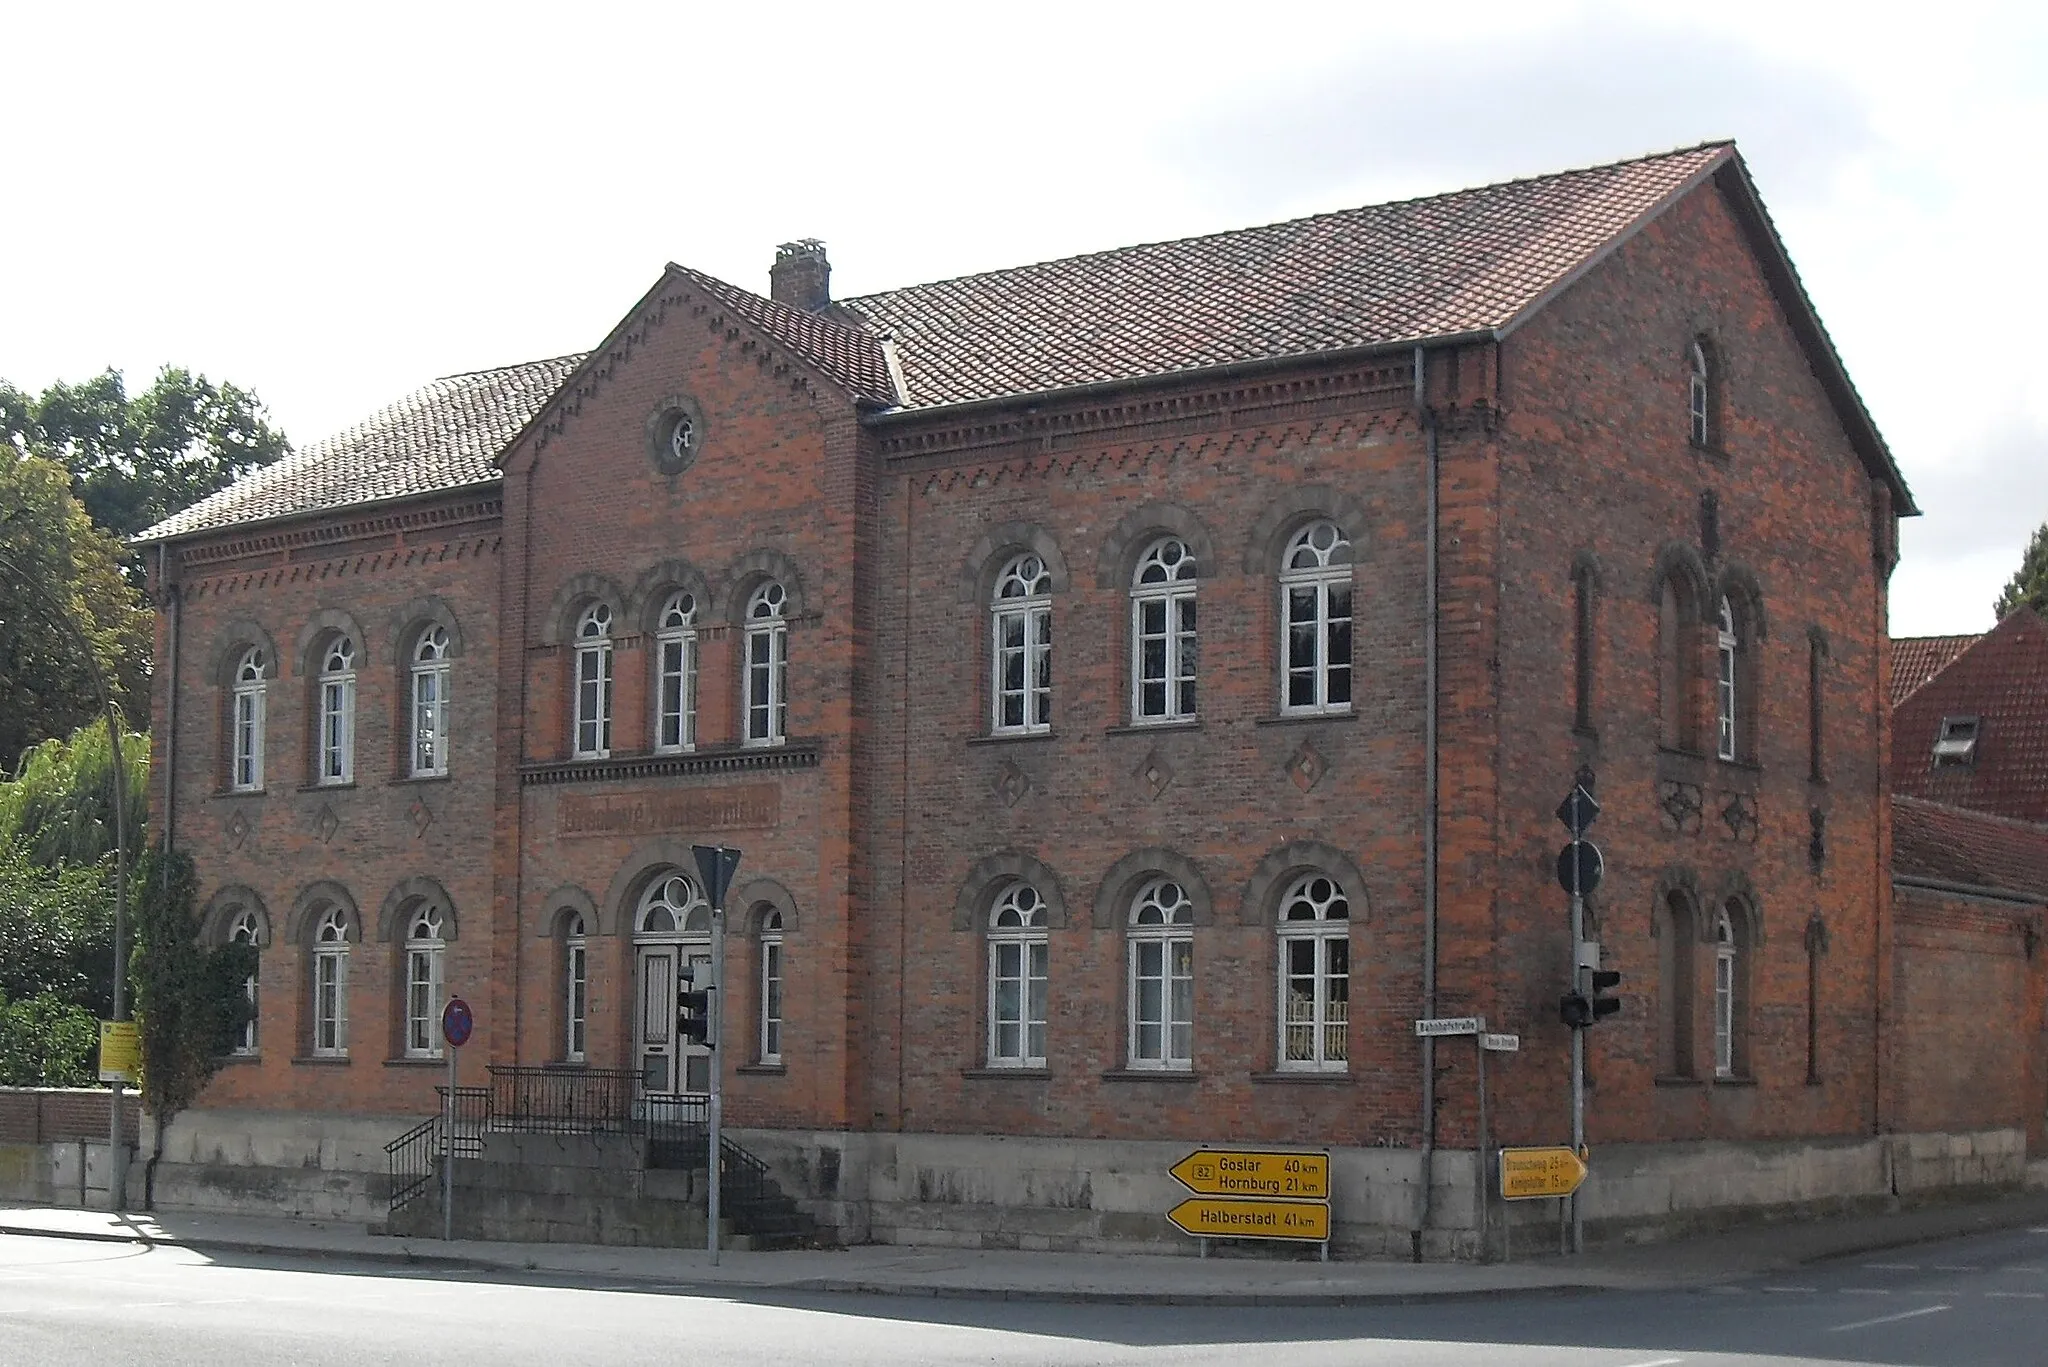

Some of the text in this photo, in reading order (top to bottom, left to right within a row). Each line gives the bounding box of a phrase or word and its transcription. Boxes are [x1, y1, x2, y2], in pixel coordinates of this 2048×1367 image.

[1219, 1157, 1318, 1174] Goslar 40 km
[1550, 1156, 1559, 1169] 25
[1197, 1167, 1210, 1178] 82
[1219, 1176, 1318, 1194] Hornburg 21 km
[1551, 1174, 1559, 1188] 15
[1200, 1209, 1315, 1228] Halberstadt 41 km
